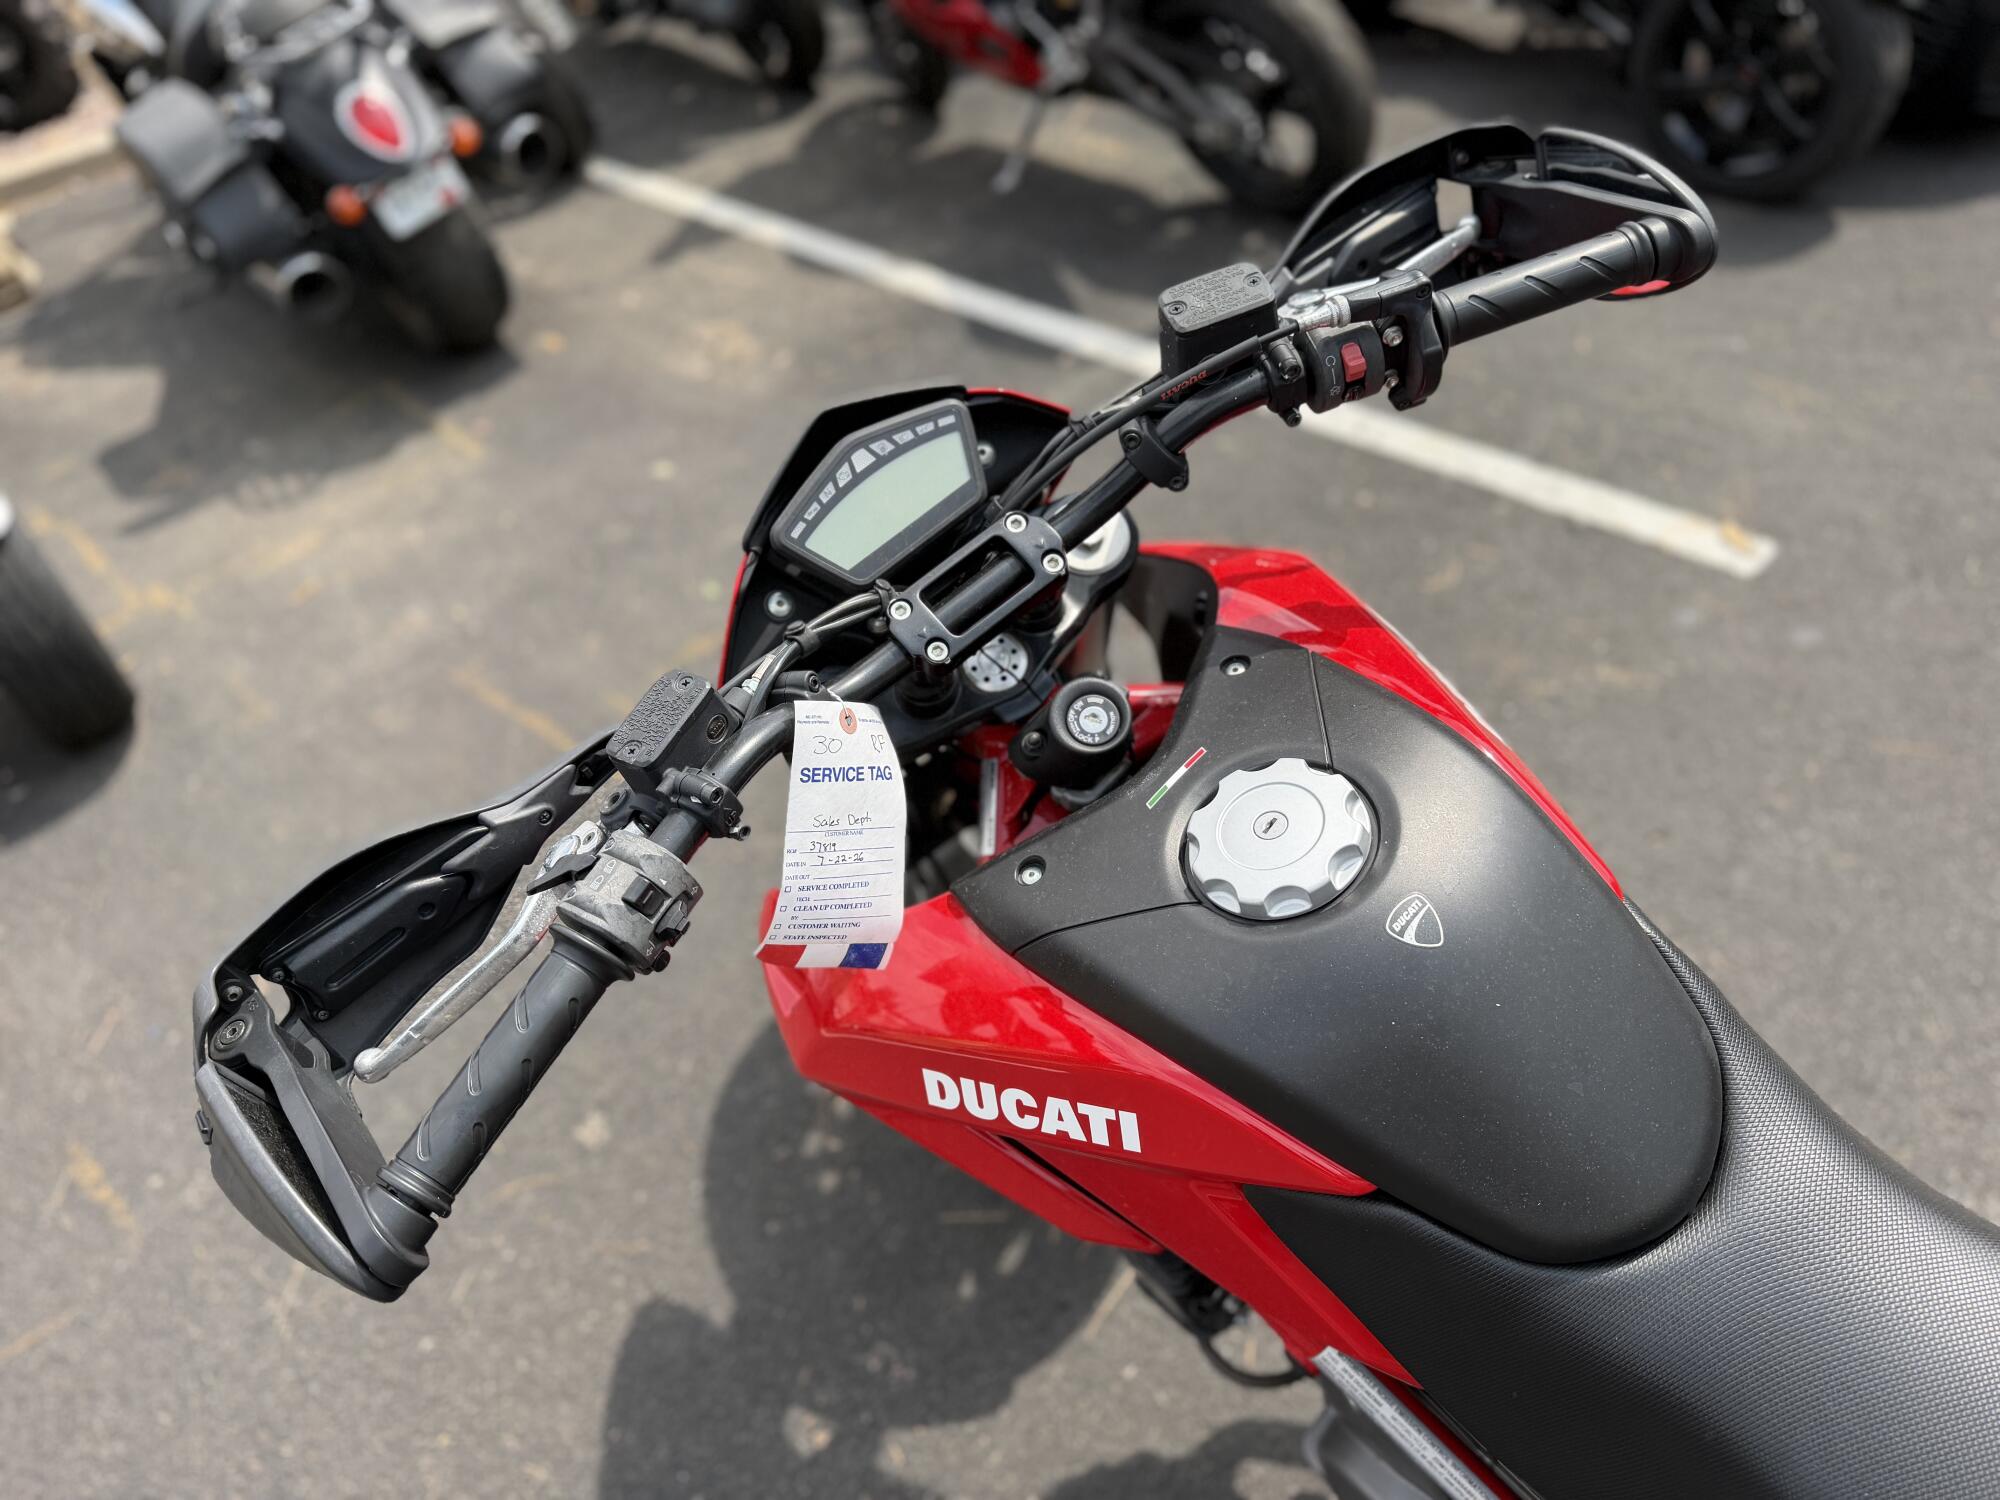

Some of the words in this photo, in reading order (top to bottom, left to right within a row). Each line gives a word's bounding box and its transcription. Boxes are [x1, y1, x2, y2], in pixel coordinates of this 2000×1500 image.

[813, 735, 842, 754] 30
[800, 766, 865, 783] SERVICE
[868, 765, 893, 781] TAG
[812, 814, 840, 828] Sales
[828, 882, 870, 890] COMPLETED
[830, 902, 872, 910] COMPLETED
[1392, 899, 1423, 932] DUCATI
[922, 1068, 1142, 1154] DUCATI
